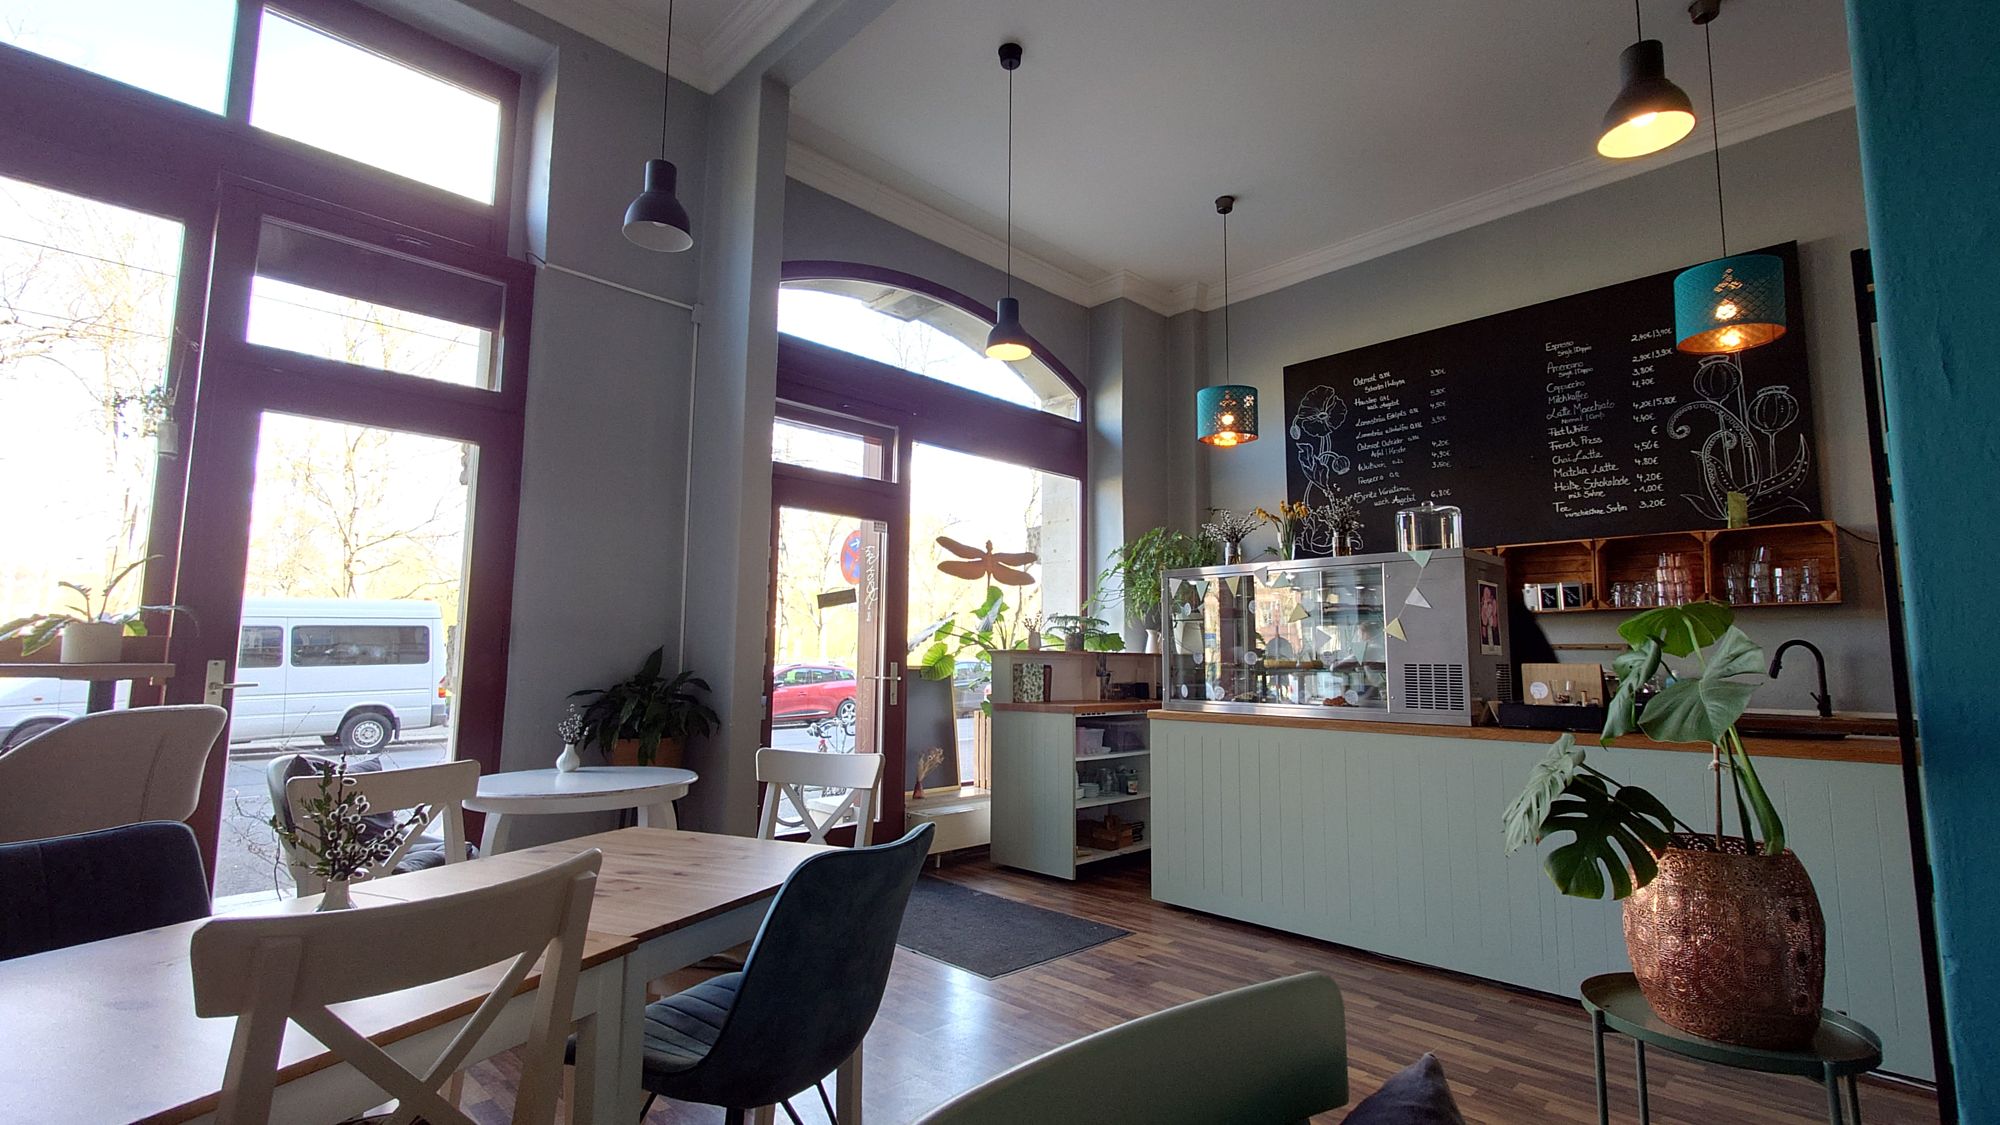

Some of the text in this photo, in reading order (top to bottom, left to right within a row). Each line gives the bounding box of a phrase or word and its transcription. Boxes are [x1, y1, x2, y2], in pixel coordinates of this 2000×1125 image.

[1546, 341, 1574, 352] Espresso
[1547, 362, 1584, 373] Americano
[1546, 381, 1585, 393] Cappuccino
[1548, 390, 1589, 404] Milchkaffee
[1547, 428, 1565, 436] Flat
[1566, 424, 1590, 434] White
[1548, 425, 1658, 451] French Press €
[1552, 453, 1572, 464] Chai
[1571, 448, 1603, 462] Latte
[1553, 466, 1589, 478] Matcha
[1591, 462, 1619, 474] Latte
[1554, 472, 1663, 492] Heiße Schokolade 4,20€
[1568, 492, 1581, 500] mit
[1583, 490, 1605, 498] Sahne
[1552, 499, 1666, 513] Tee 3,20€
[1606, 502, 1628, 513] Sorten
